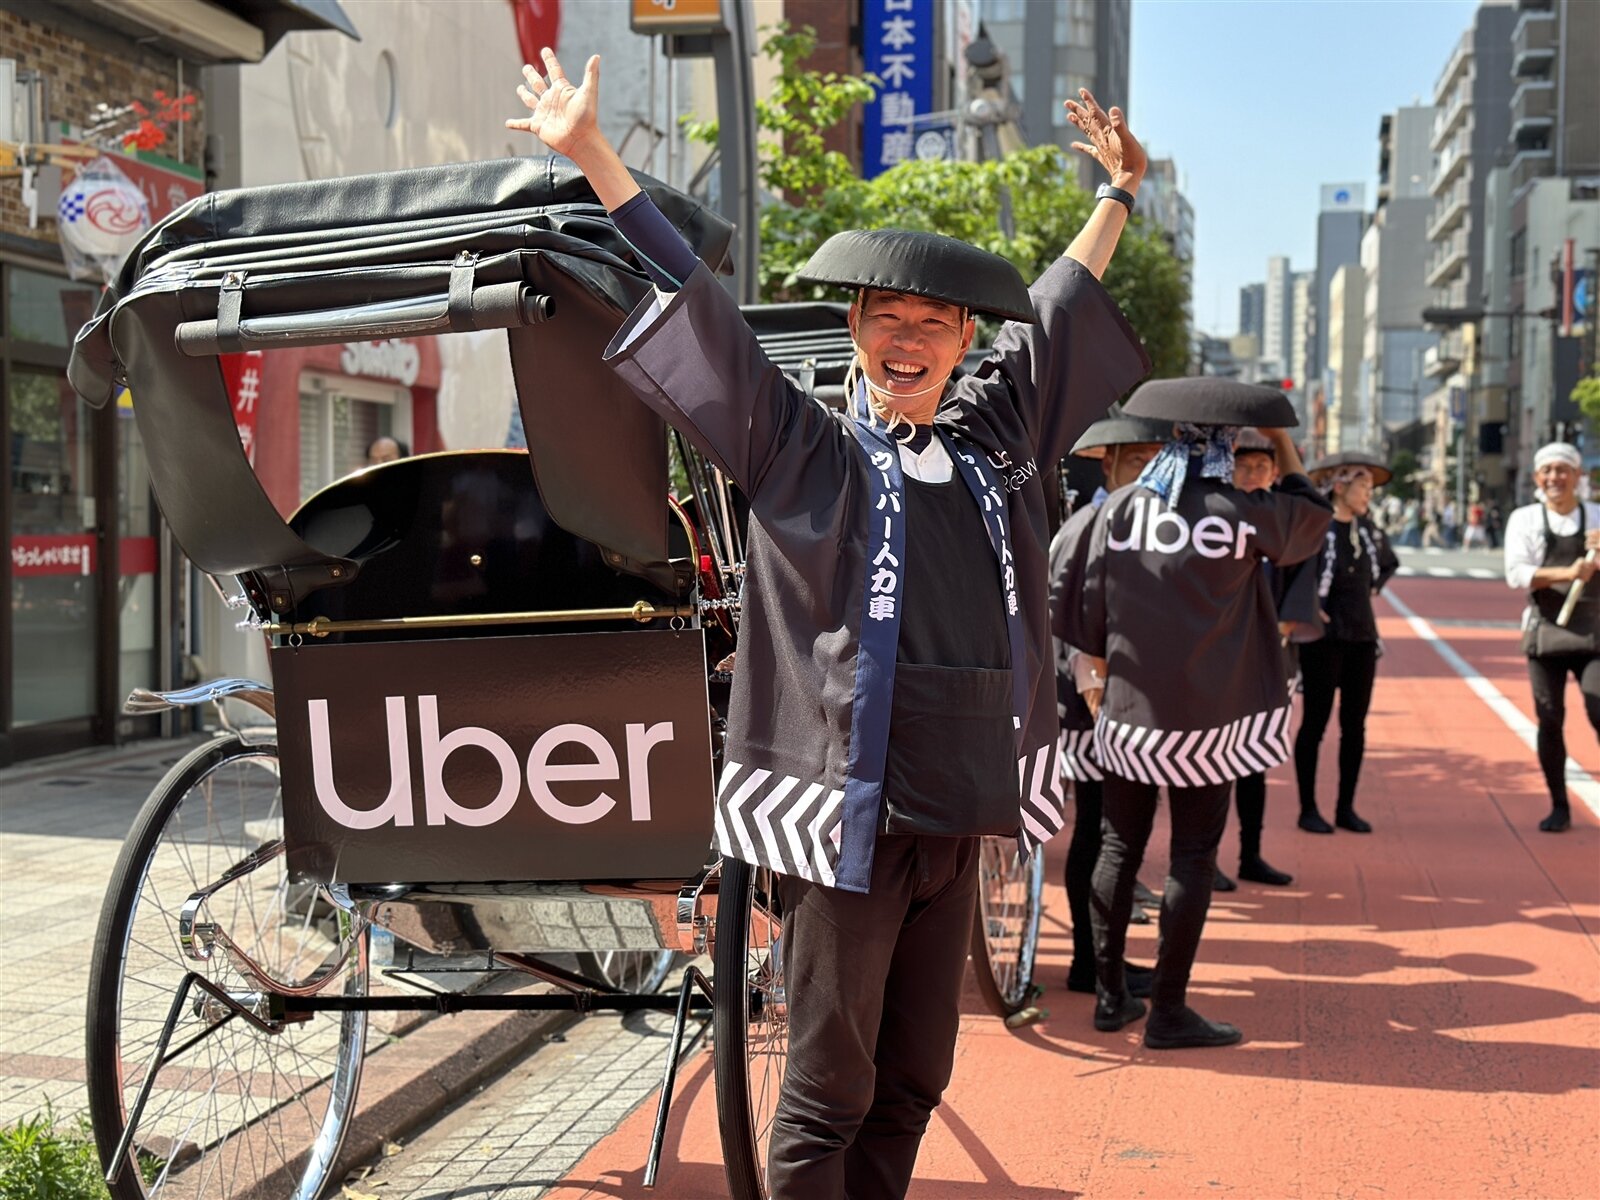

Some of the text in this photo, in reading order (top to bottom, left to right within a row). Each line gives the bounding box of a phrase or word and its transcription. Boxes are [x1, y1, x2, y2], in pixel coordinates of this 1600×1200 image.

[869, 451, 901, 621] ウーバー人力車
[1107, 497, 1257, 560] Uber
[308, 695, 674, 829] Uber
